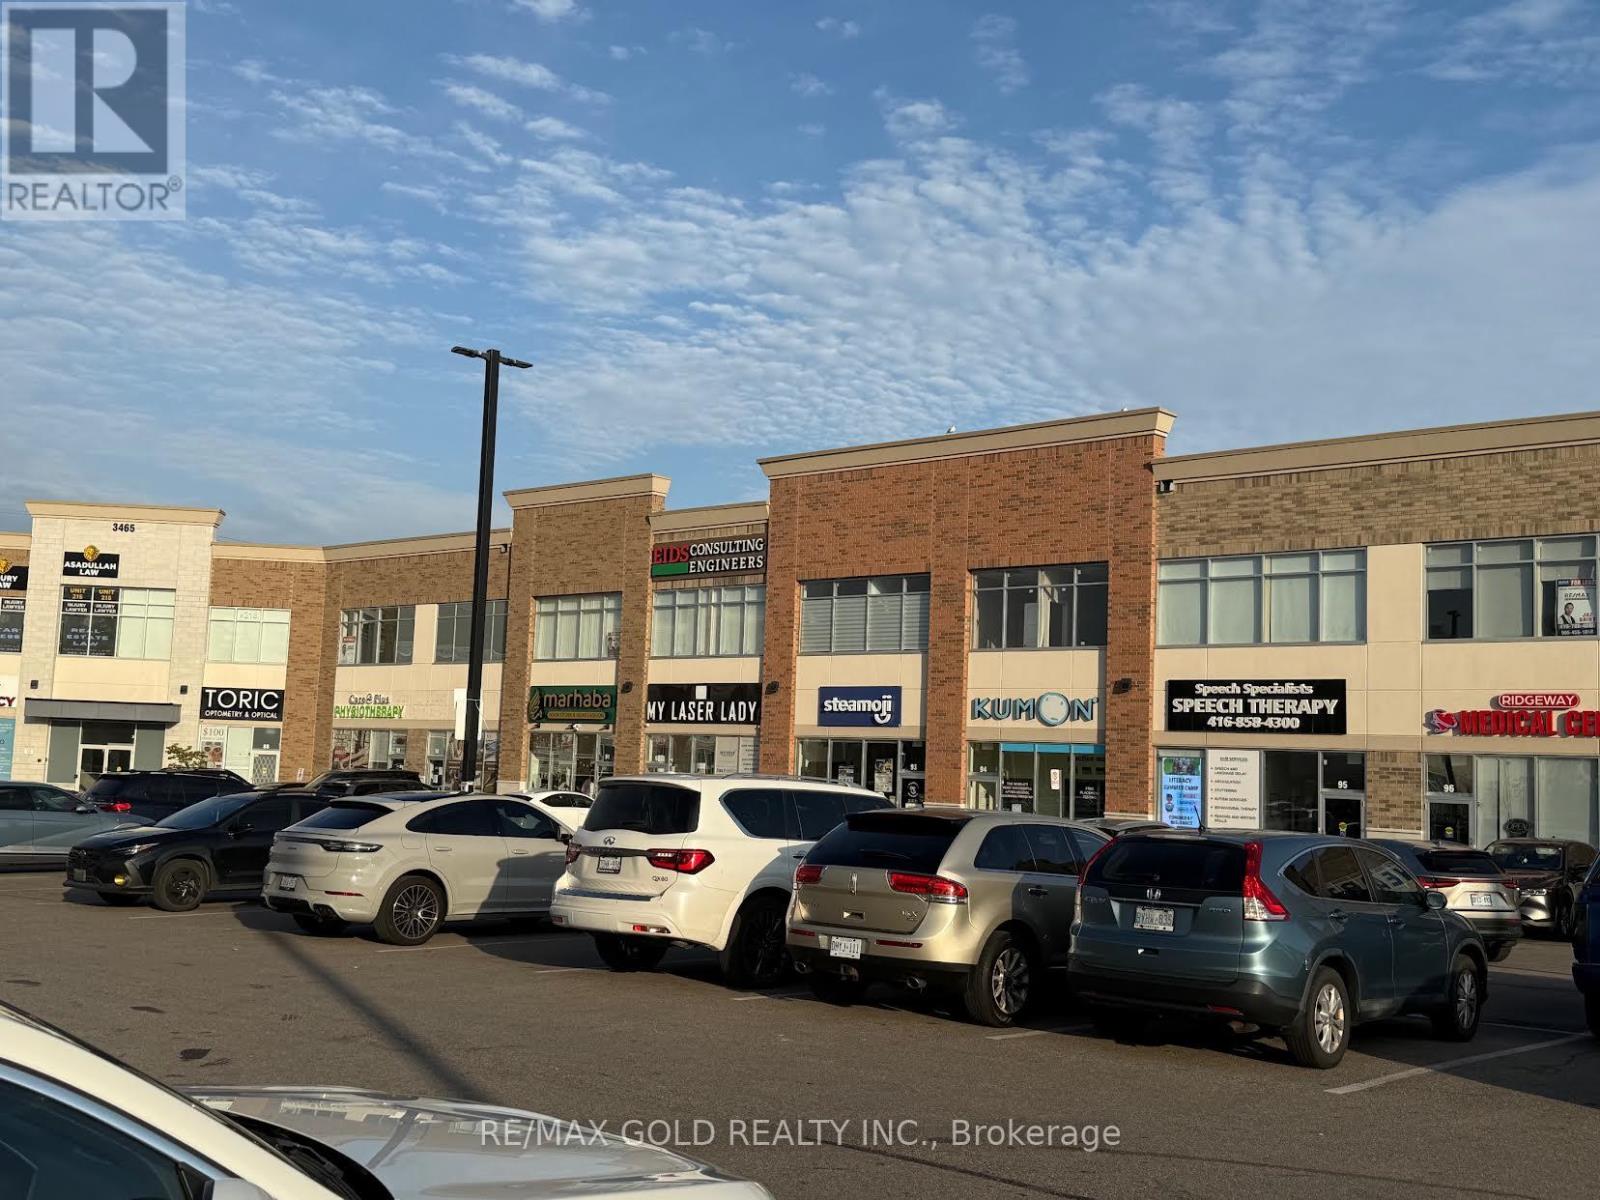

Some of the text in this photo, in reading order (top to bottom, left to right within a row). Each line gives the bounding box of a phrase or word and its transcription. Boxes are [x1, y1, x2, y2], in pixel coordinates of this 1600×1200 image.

[112, 522, 135, 532] 3465
[690, 538, 764, 557] CONSULTING
[64, 561, 117, 570] ASADULLAH
[689, 555, 764, 574] ENGINEERS
[1195, 683, 1313, 696] Speech Specialists
[204, 689, 280, 710] TORIC
[544, 690, 612, 708] marhaba
[1502, 695, 1575, 706] RIDGEWAY
[335, 705, 405, 718] PHYSIOTHERAPY
[647, 701, 757, 721] MY LASER LADY
[823, 694, 893, 724] steamoji
[1172, 698, 1338, 715] SPEECH THERAPY
[204, 709, 243, 718] OPTOMETRY
[1206, 716, 1301, 729] 416-858-4300
[1460, 710, 1558, 736] MEDICAL
[203, 727, 224, 737] $100
[1337, 780, 1348, 790] 95
